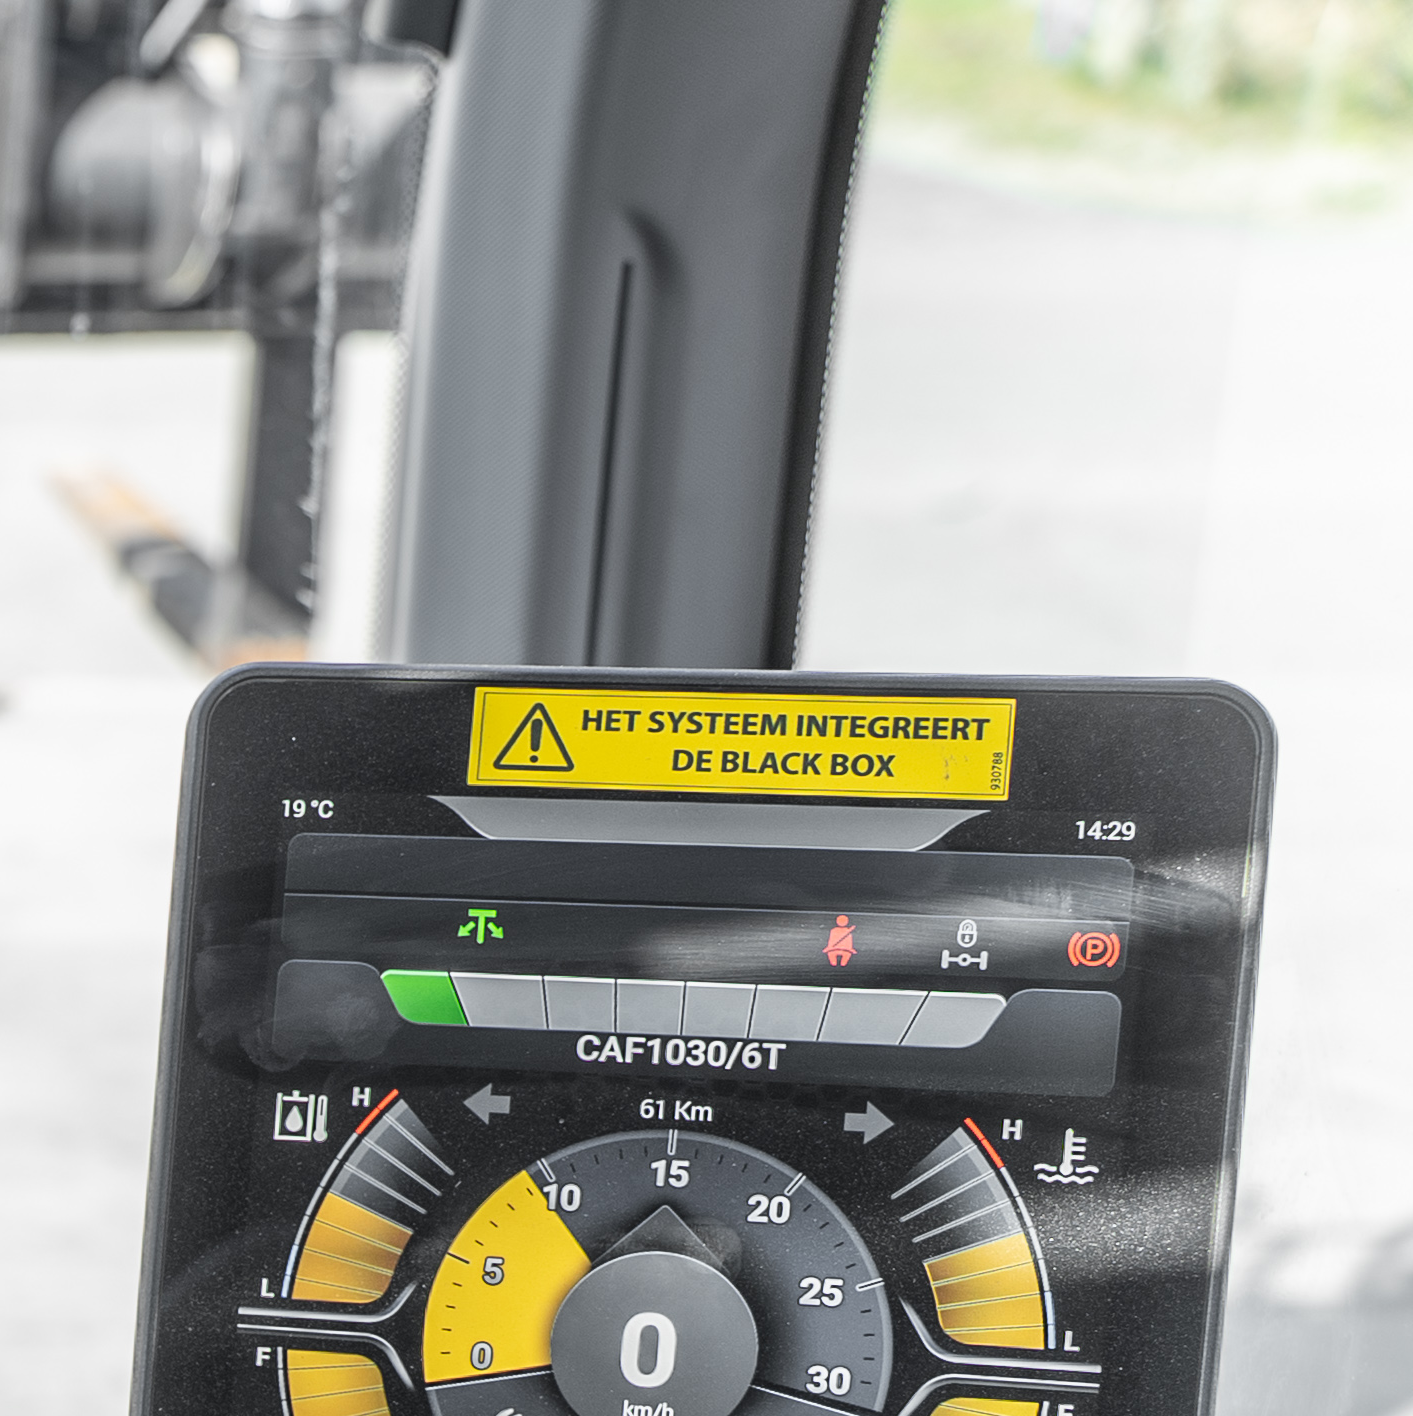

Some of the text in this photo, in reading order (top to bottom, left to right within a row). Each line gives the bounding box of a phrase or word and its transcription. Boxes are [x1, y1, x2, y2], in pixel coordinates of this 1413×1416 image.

[581, 709, 991, 741] HET SYSTEEM INTEGREERT
[671, 749, 896, 778] DE BLACK BOX
[990, 752, 1004, 791] 930788
[1075, 820, 1137, 841] 14:29
[575, 1034, 788, 1071] CAF1030/6T
[351, 1086, 371, 1108] H
[639, 1098, 713, 1122] 61 Km
[1001, 1118, 1023, 1141] H
[649, 1159, 690, 1188] 15
[540, 1183, 581, 1213] 10
[746, 1194, 791, 1224] 20
[481, 1256, 505, 1286] 5
[260, 1277, 275, 1299] L
[798, 1276, 844, 1307] 25
[470, 1341, 493, 1370] 0
[620, 1311, 678, 1388] 0
[1063, 1330, 1081, 1352] L
[255, 1346, 272, 1367] F
[805, 1364, 852, 1396] 30
